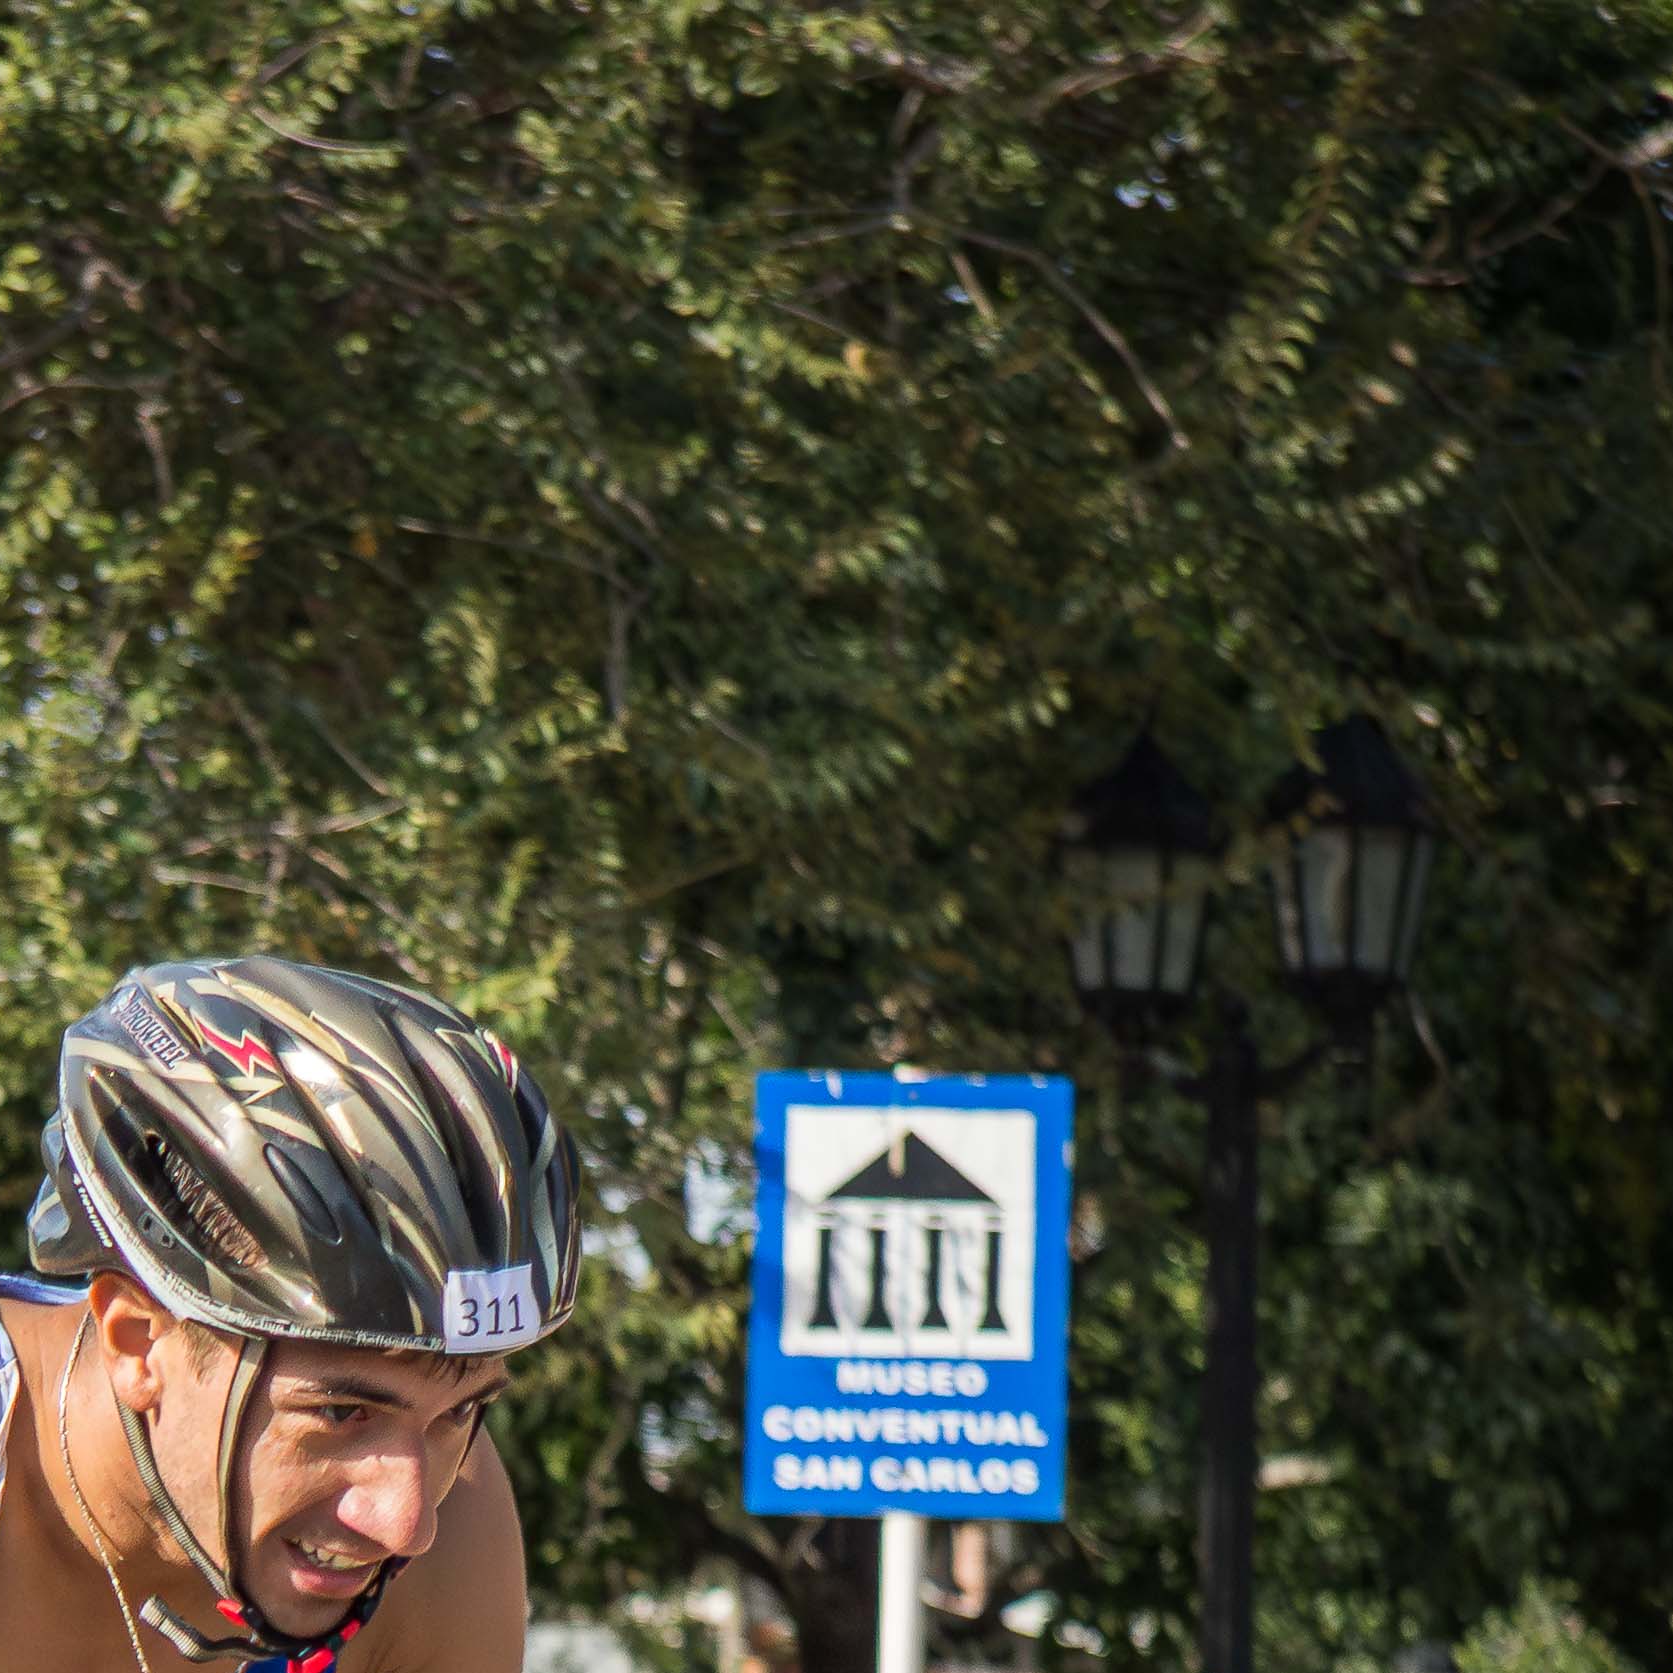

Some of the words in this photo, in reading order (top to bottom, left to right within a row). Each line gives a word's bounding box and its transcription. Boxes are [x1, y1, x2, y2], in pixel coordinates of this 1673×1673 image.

[457, 1293, 526, 1337] 311
[836, 1361, 989, 1398] MUSEO
[762, 1405, 1049, 1447] CONVENTUAL
[773, 1453, 863, 1491] SAN
[869, 1457, 1040, 1495] CARLOS
